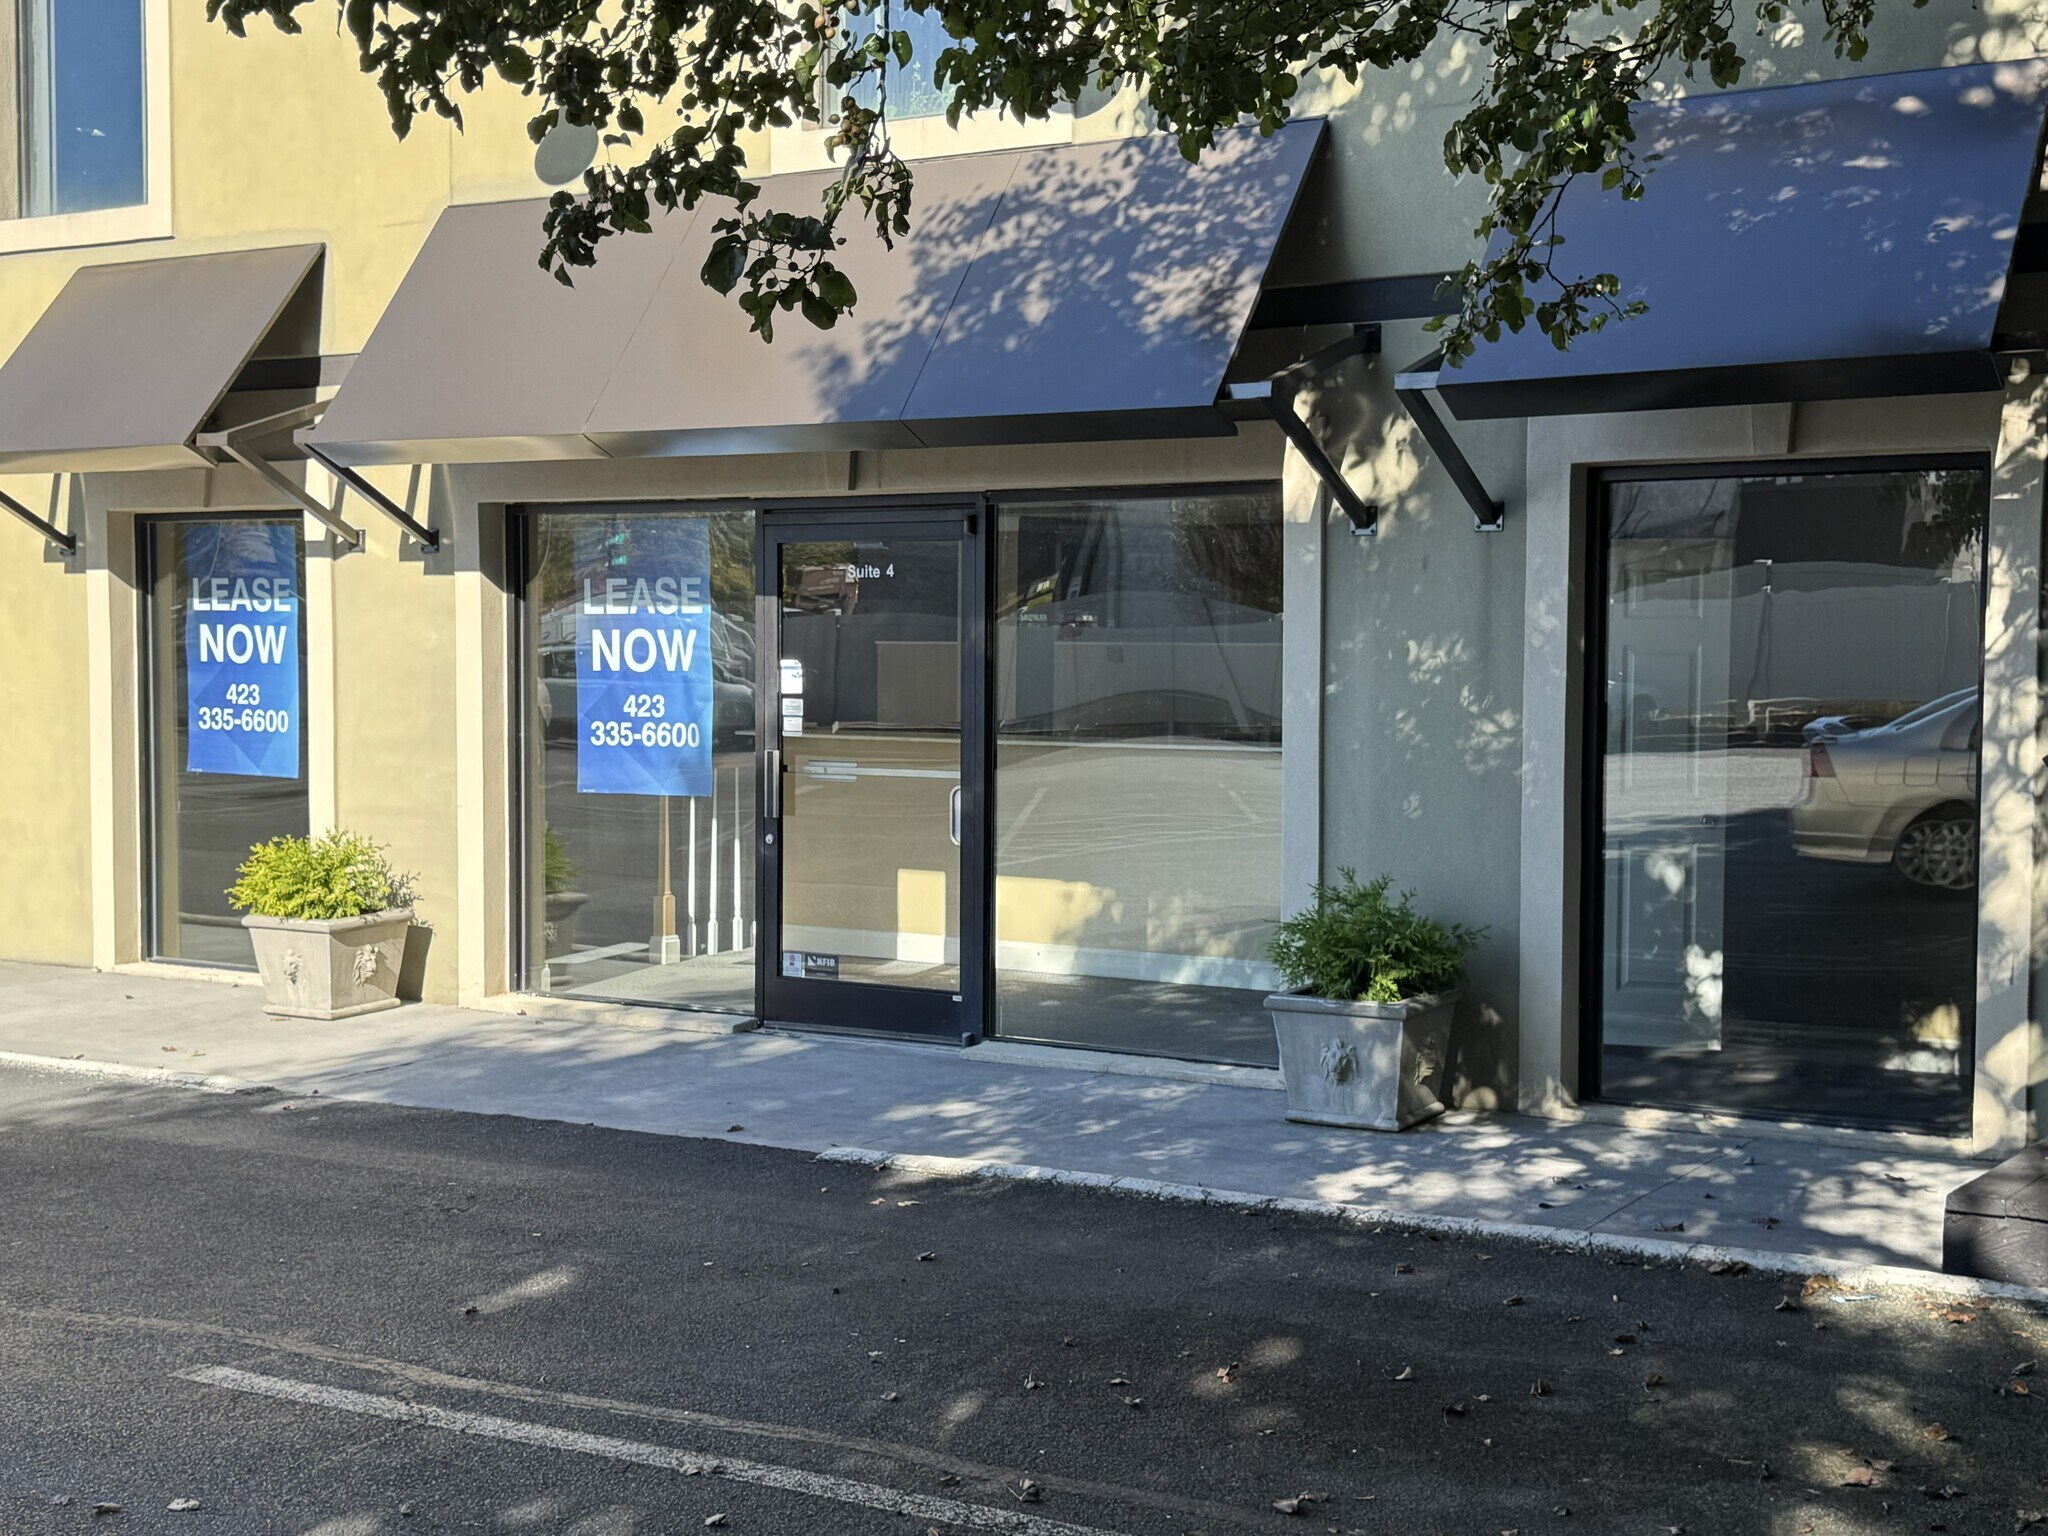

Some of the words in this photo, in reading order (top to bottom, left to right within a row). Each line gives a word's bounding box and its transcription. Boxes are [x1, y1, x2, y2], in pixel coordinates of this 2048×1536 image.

[847, 564, 880, 579] Suite
[886, 563, 895, 578] 4
[192, 577, 291, 613] LEASE
[583, 576, 703, 615] LEASE
[199, 623, 287, 665] NOW
[591, 628, 697, 673] NOW
[226, 683, 260, 706] 423
[623, 694, 665, 718] 423
[198, 706, 289, 734] 335-6600
[590, 720, 700, 748] 335-6600
